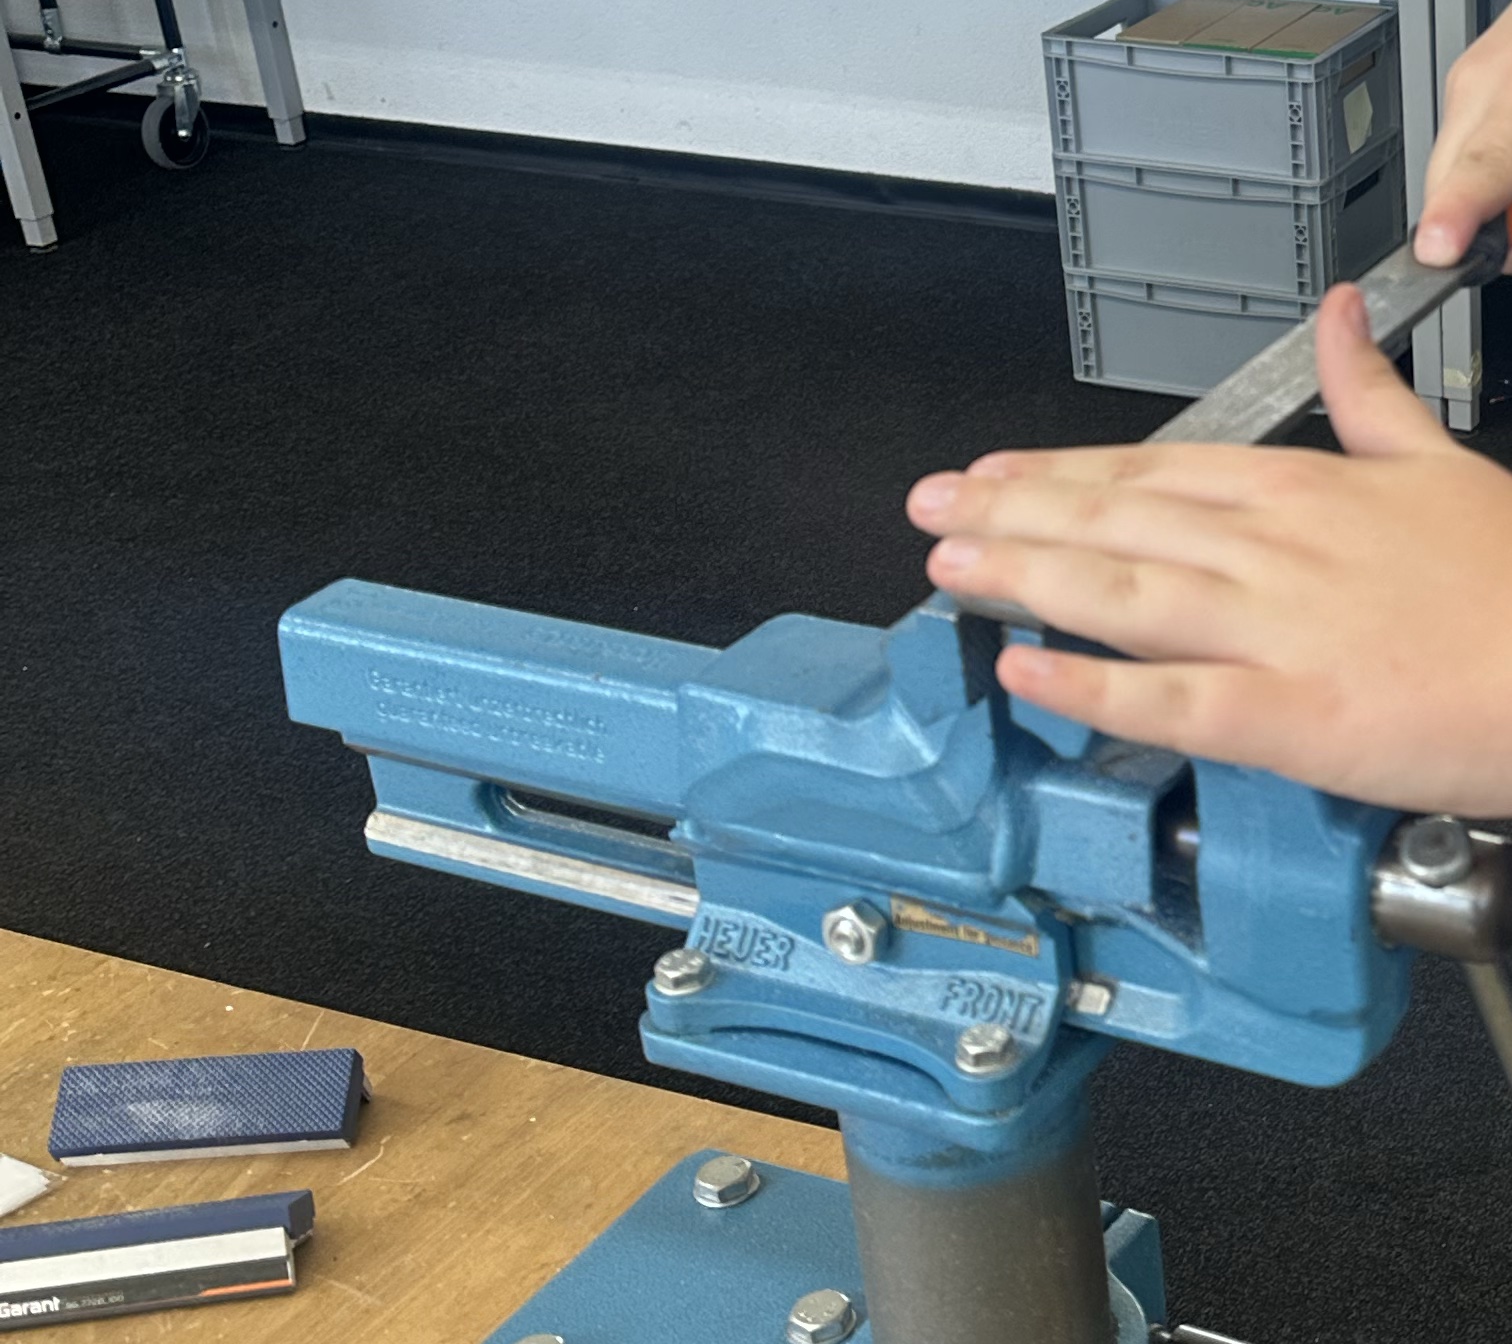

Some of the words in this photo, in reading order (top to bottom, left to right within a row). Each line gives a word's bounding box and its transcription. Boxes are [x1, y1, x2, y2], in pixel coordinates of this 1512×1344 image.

[693, 914, 797, 972] HEUER
[938, 975, 1046, 1035] FRONT
[0, 1295, 60, 1318] Garant
